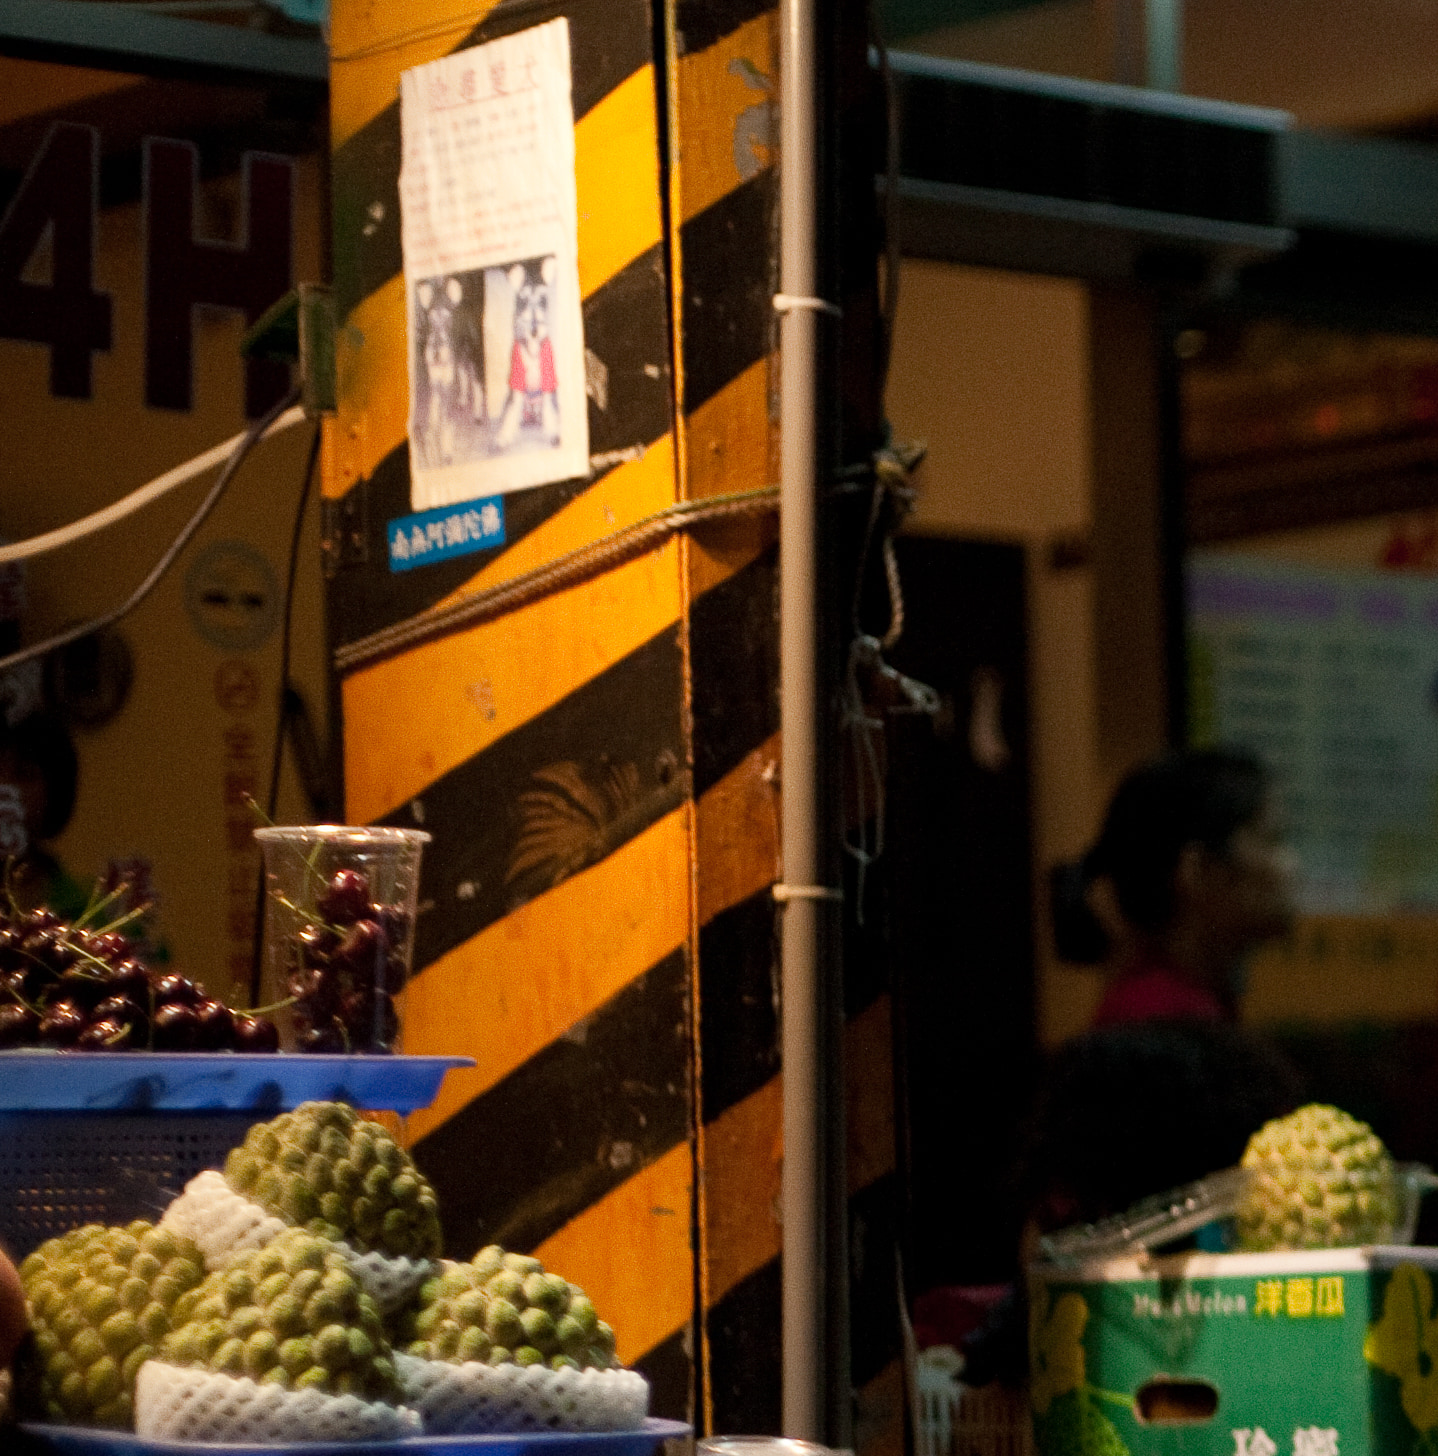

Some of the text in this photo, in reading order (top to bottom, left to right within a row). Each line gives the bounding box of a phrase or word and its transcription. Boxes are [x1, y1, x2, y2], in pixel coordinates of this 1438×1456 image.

[390, 502, 502, 561] 南無阿彌陀佛
[1253, 1276, 1345, 1319] 洋香瓜
